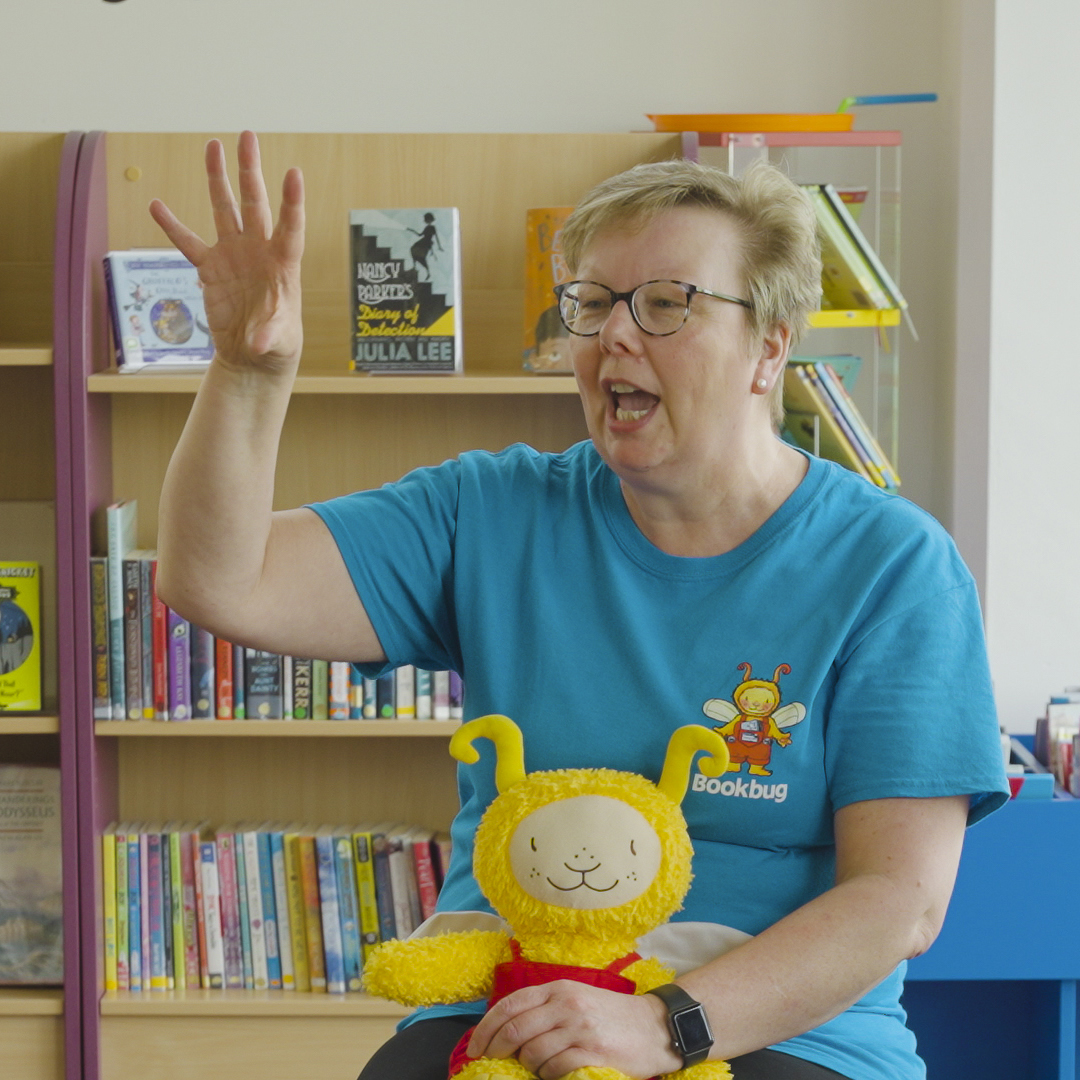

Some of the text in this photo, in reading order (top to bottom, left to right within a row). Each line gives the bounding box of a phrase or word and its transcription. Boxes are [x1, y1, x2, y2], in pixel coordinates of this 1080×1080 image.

[357, 262, 401, 283] NANCY
[357, 283, 414, 304] PARKER'S
[357, 304, 419, 324] Diary of
[356, 321, 429, 337] Detection
[354, 341, 453, 362] JULIA LEE
[294, 665, 311, 709] KERR
[691, 773, 788, 804] Bookbug
